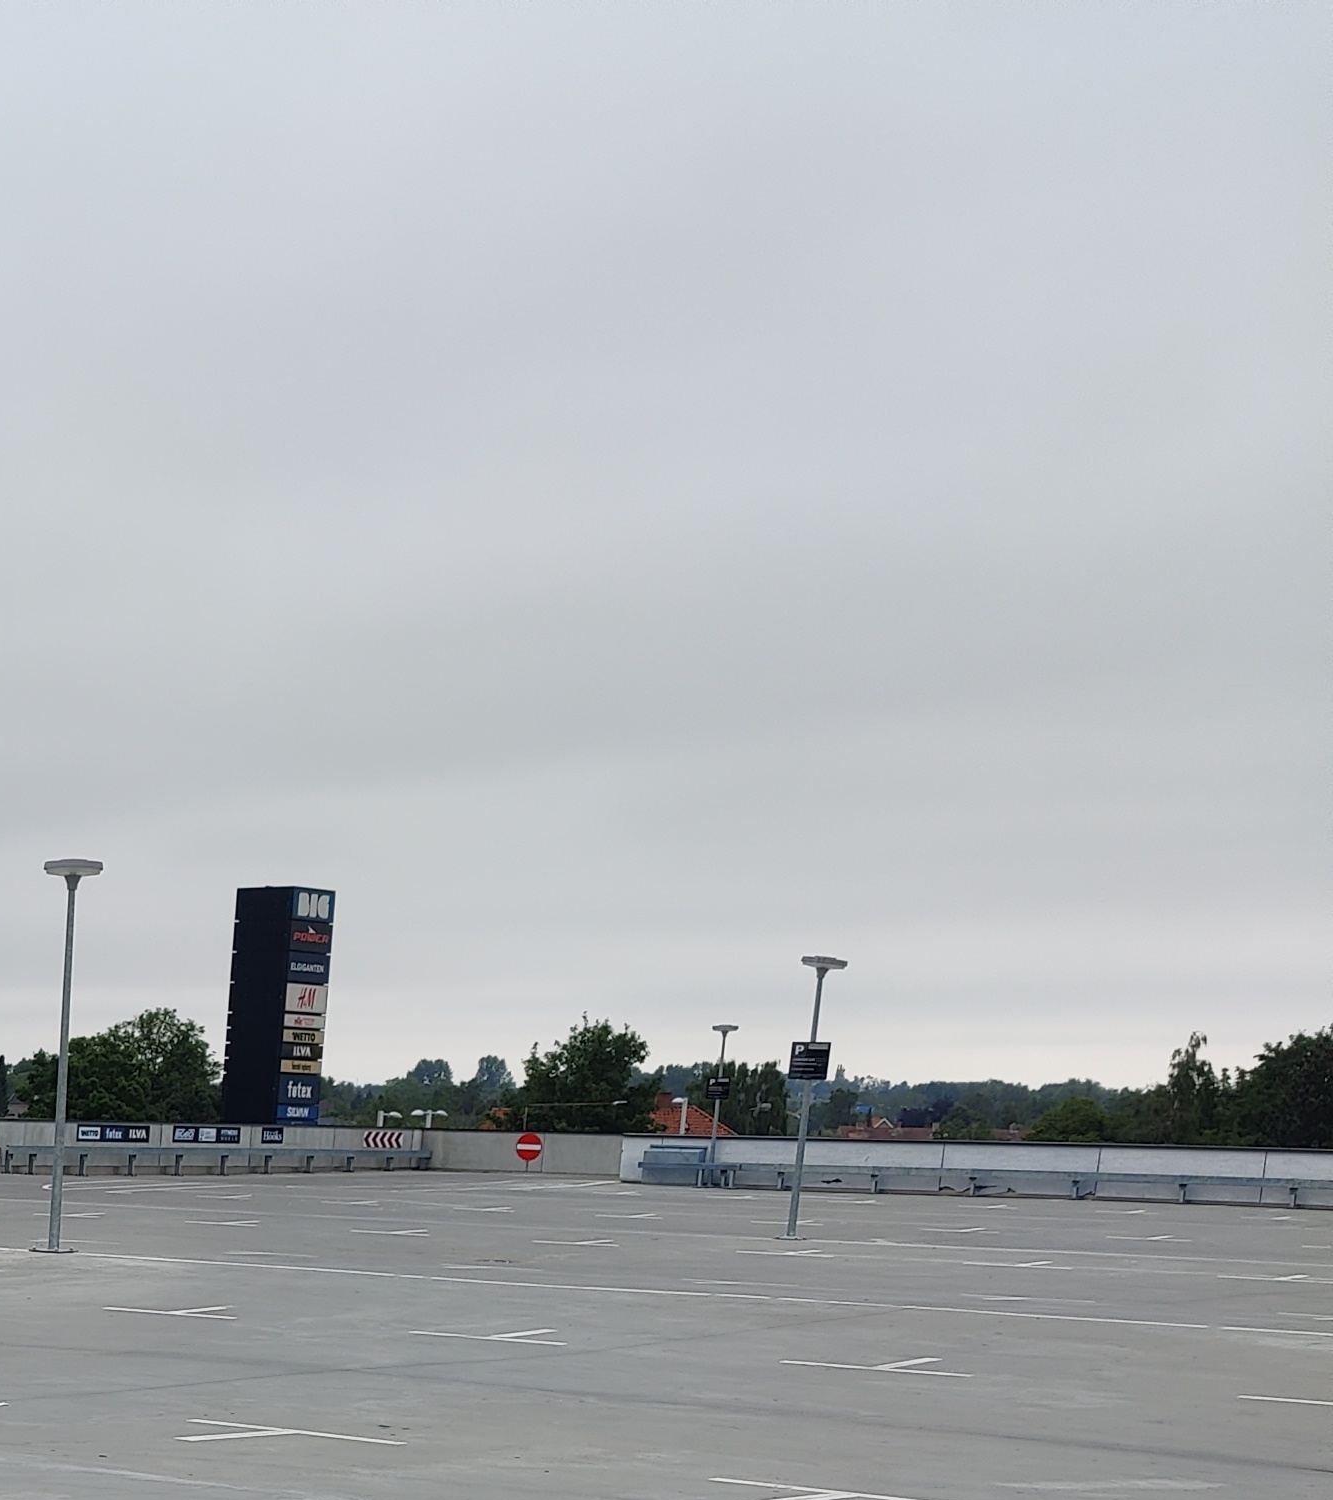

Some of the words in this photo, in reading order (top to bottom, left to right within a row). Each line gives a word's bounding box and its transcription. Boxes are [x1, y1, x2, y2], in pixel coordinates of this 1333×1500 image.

[297, 892, 330, 920] BIG
[293, 931, 329, 943] POWER
[290, 962, 325, 973] ELGIGANTEN
[293, 1045, 312, 1057] ILVA
[794, 1044, 805, 1055] P
[128, 1128, 148, 1140] ILVA
